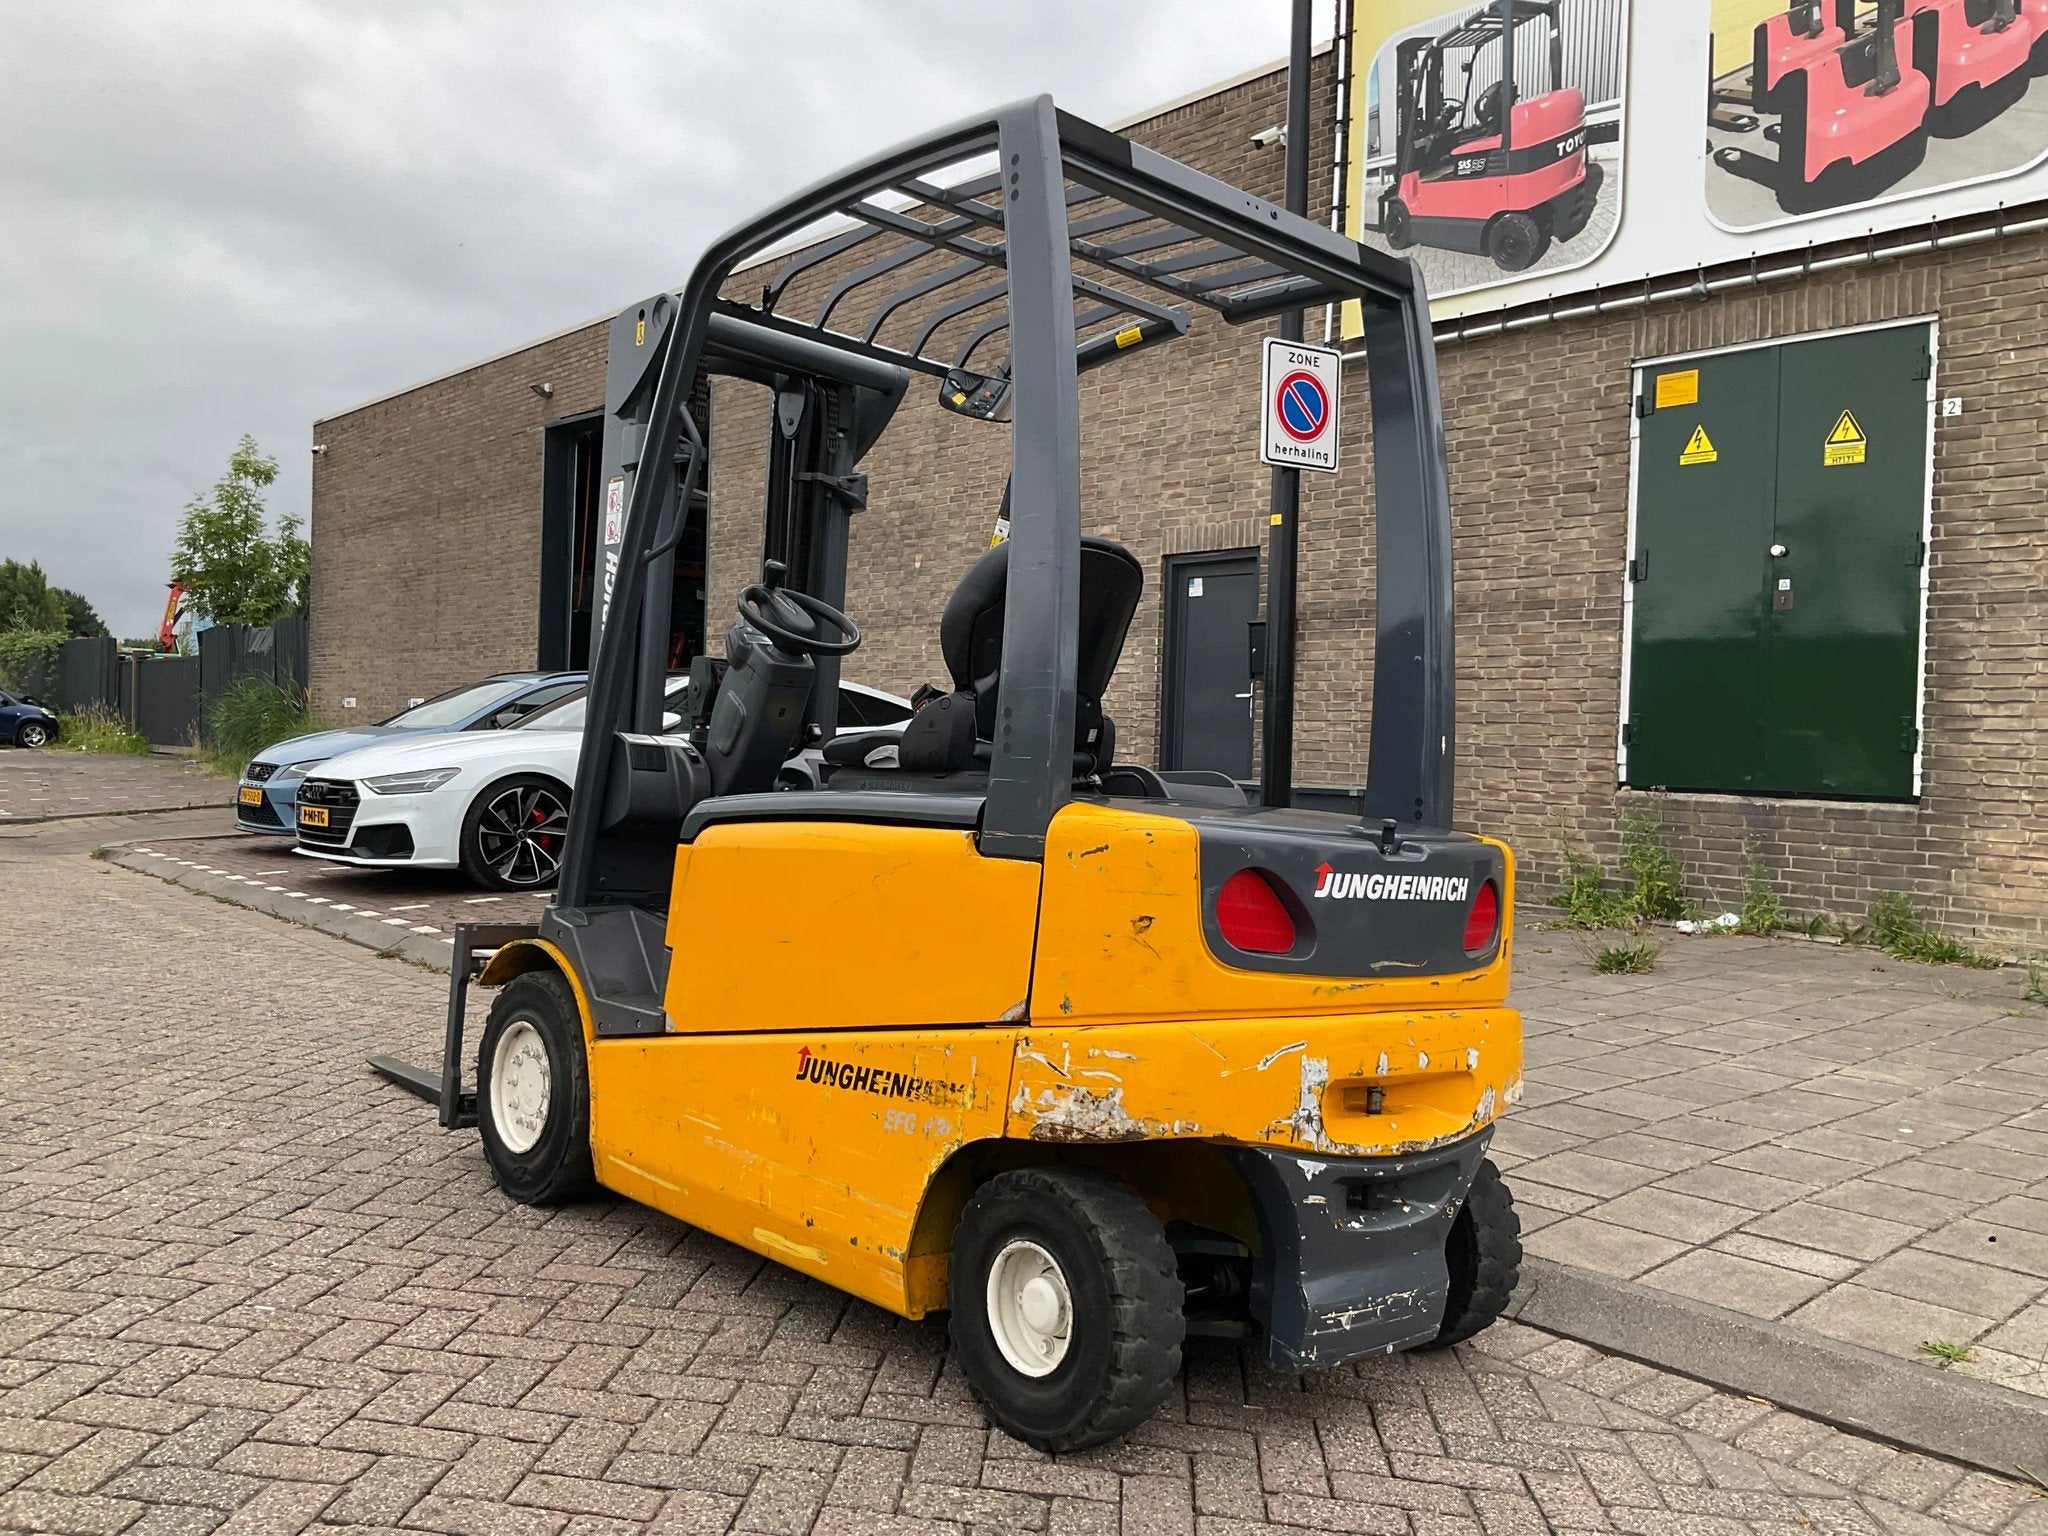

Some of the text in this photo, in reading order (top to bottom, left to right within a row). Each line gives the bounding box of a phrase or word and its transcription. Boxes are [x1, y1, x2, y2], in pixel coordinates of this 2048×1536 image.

[1288, 351, 1320, 368] ZONE
[1947, 400, 1957, 415] 2
[1274, 442, 1329, 464] herhaling
[1314, 871, 1469, 902] JUNGHEINRICH
[883, 1108, 917, 1135] EFG
